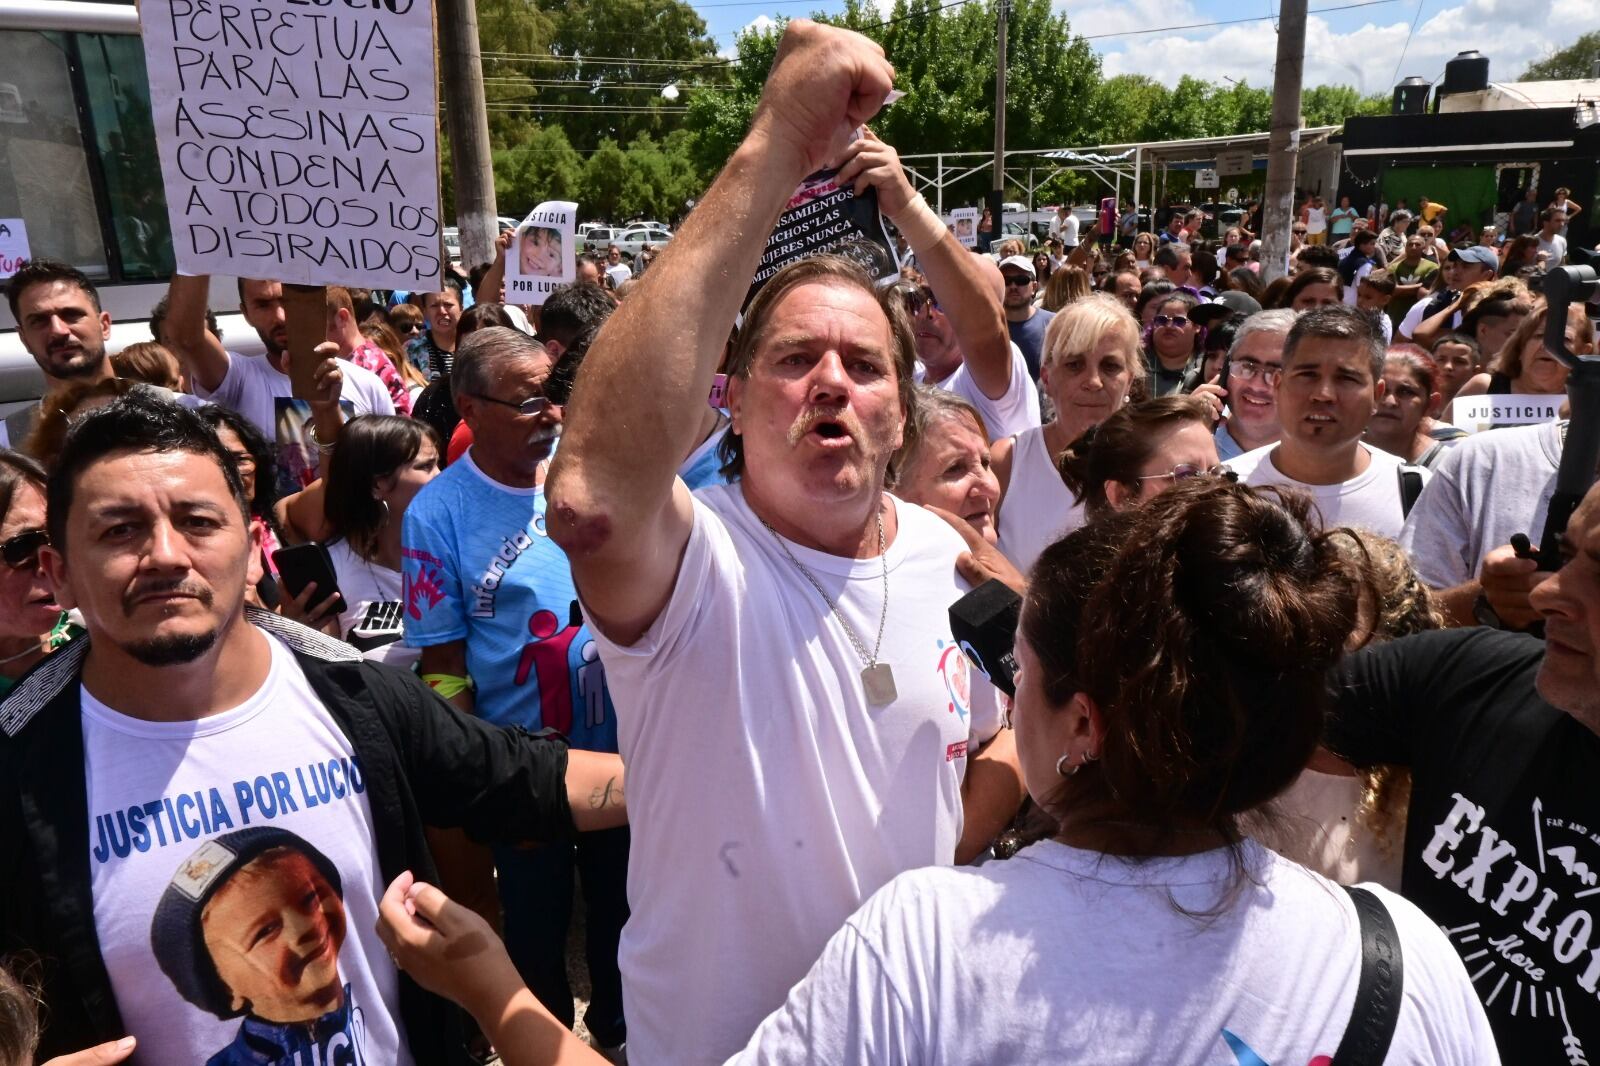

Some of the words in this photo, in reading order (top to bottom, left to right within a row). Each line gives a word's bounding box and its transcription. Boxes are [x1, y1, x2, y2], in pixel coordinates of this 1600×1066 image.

[169, 0, 402, 65] PERPETUA
[173, 46, 299, 99] PARA
[314, 61, 410, 101] LAS
[175, 97, 425, 153] ASESINAS
[176, 142, 406, 198] CONDENA
[185, 185, 213, 216] A
[219, 188, 379, 229] TODOS
[388, 201, 439, 238] LOS
[189, 223, 440, 281] DISTRAIDOS
[759, 239, 805, 266] UJERES
[805, 219, 852, 246] NUNCA
[512, 280, 533, 292] POR
[1467, 406, 1556, 419] JUSTICIA
[471, 528, 534, 619] Infancia
[93, 786, 235, 865] JUSTICIA
[232, 770, 300, 826] POR
[294, 755, 367, 809] LUCIO
[1545, 817, 1564, 828] FAR
[1421, 792, 1600, 994] EXPLO
